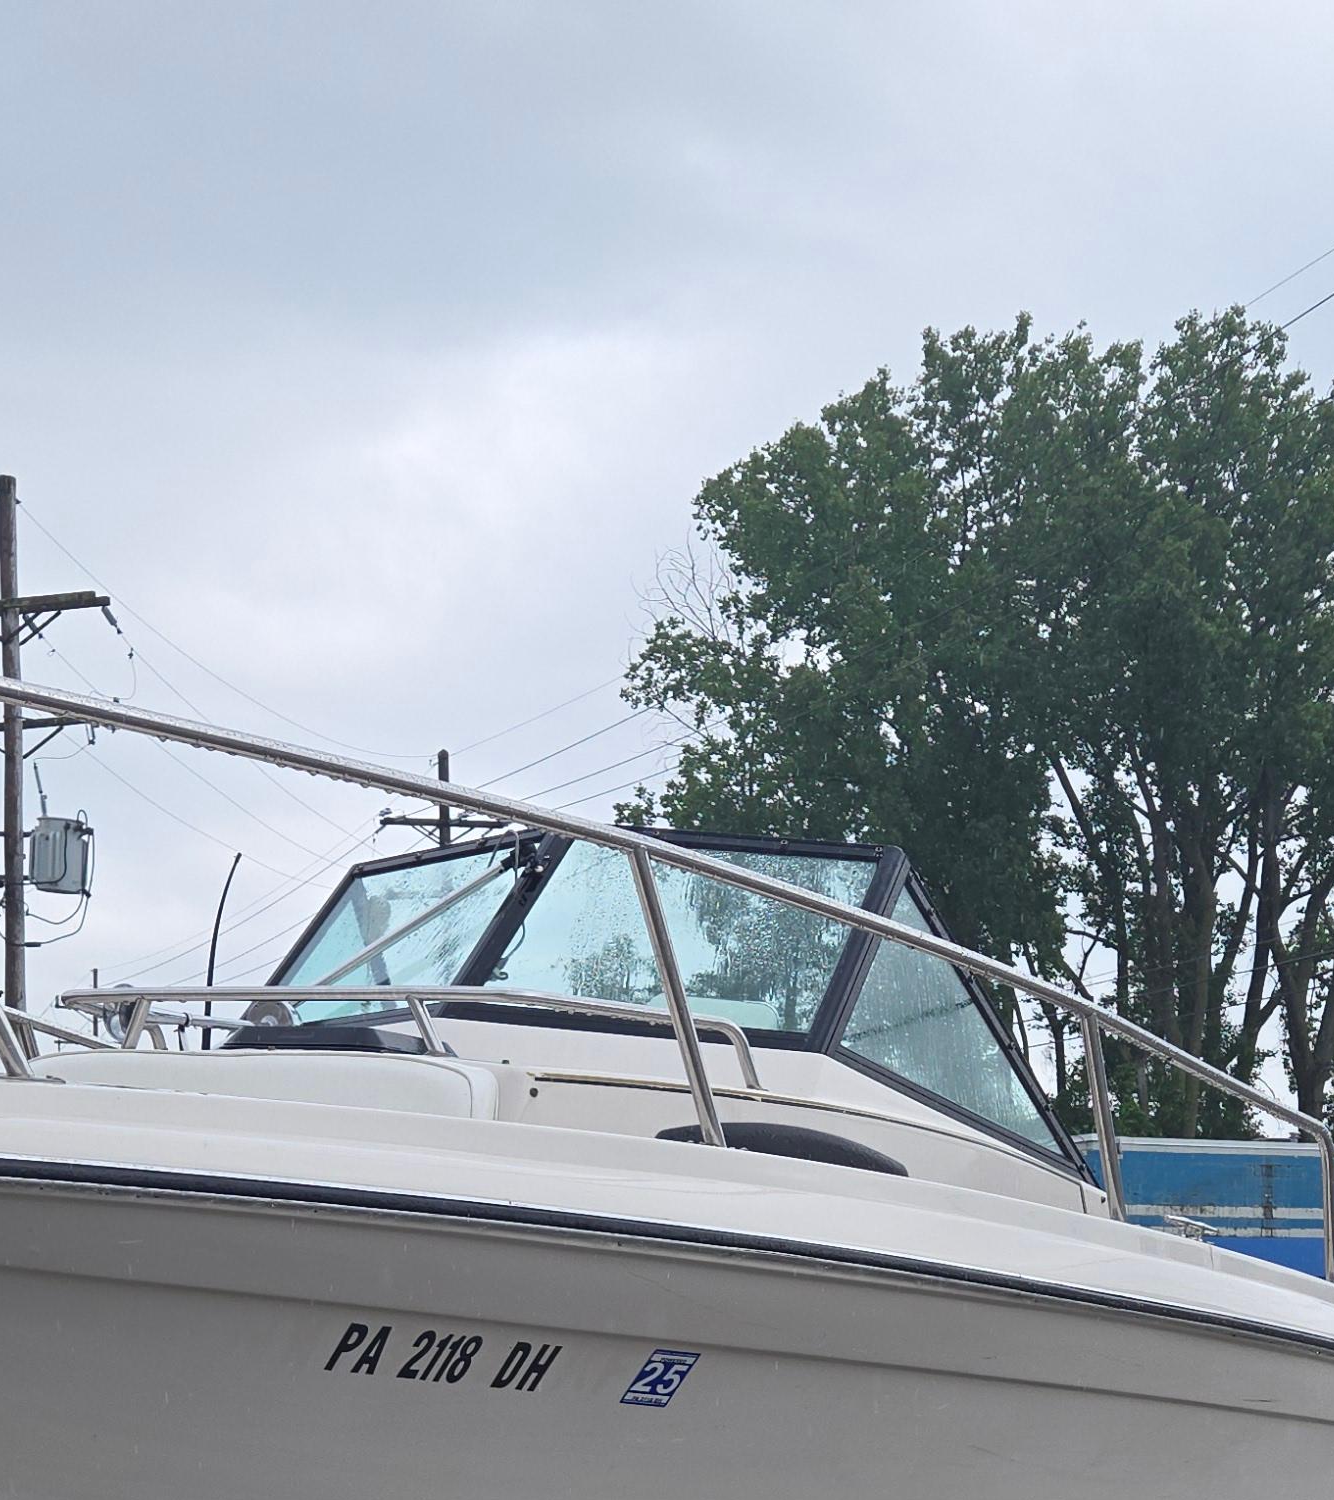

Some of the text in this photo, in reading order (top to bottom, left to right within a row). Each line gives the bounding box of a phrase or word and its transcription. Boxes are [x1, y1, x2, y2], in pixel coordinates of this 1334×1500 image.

[324, 1322, 563, 1392] PA 2118 DH
[629, 1361, 690, 1395] 25
